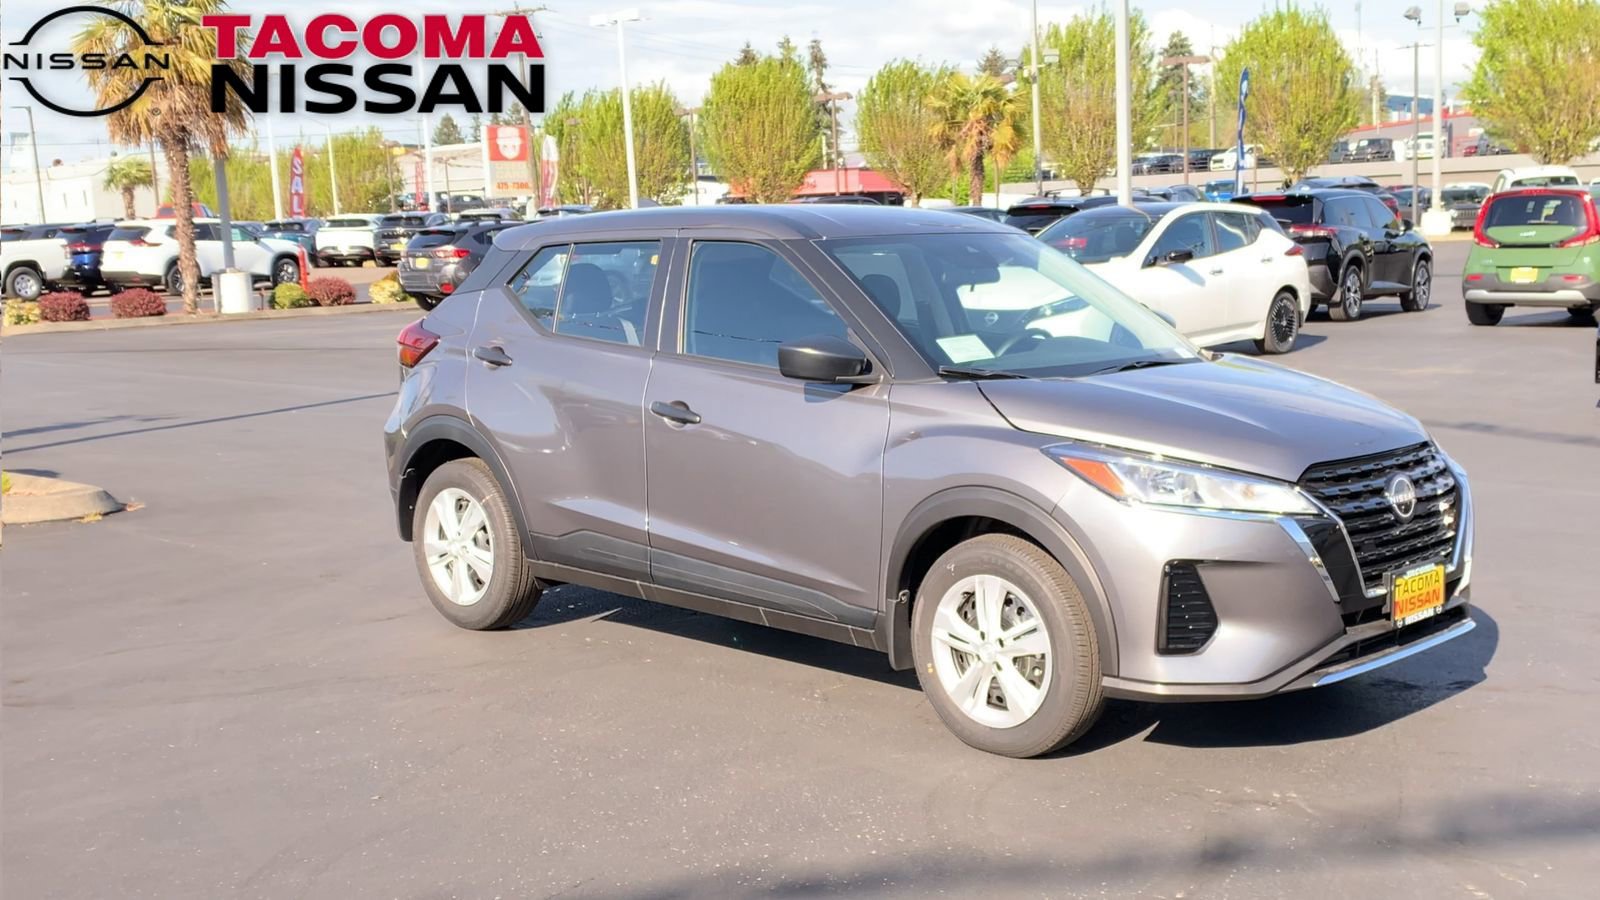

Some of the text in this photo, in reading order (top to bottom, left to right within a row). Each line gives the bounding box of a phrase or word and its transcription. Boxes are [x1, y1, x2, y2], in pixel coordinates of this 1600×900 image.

[292, 156, 304, 218] SAL
[1395, 570, 1440, 599] TACOMA
[1394, 587, 1441, 618] NISSAN
